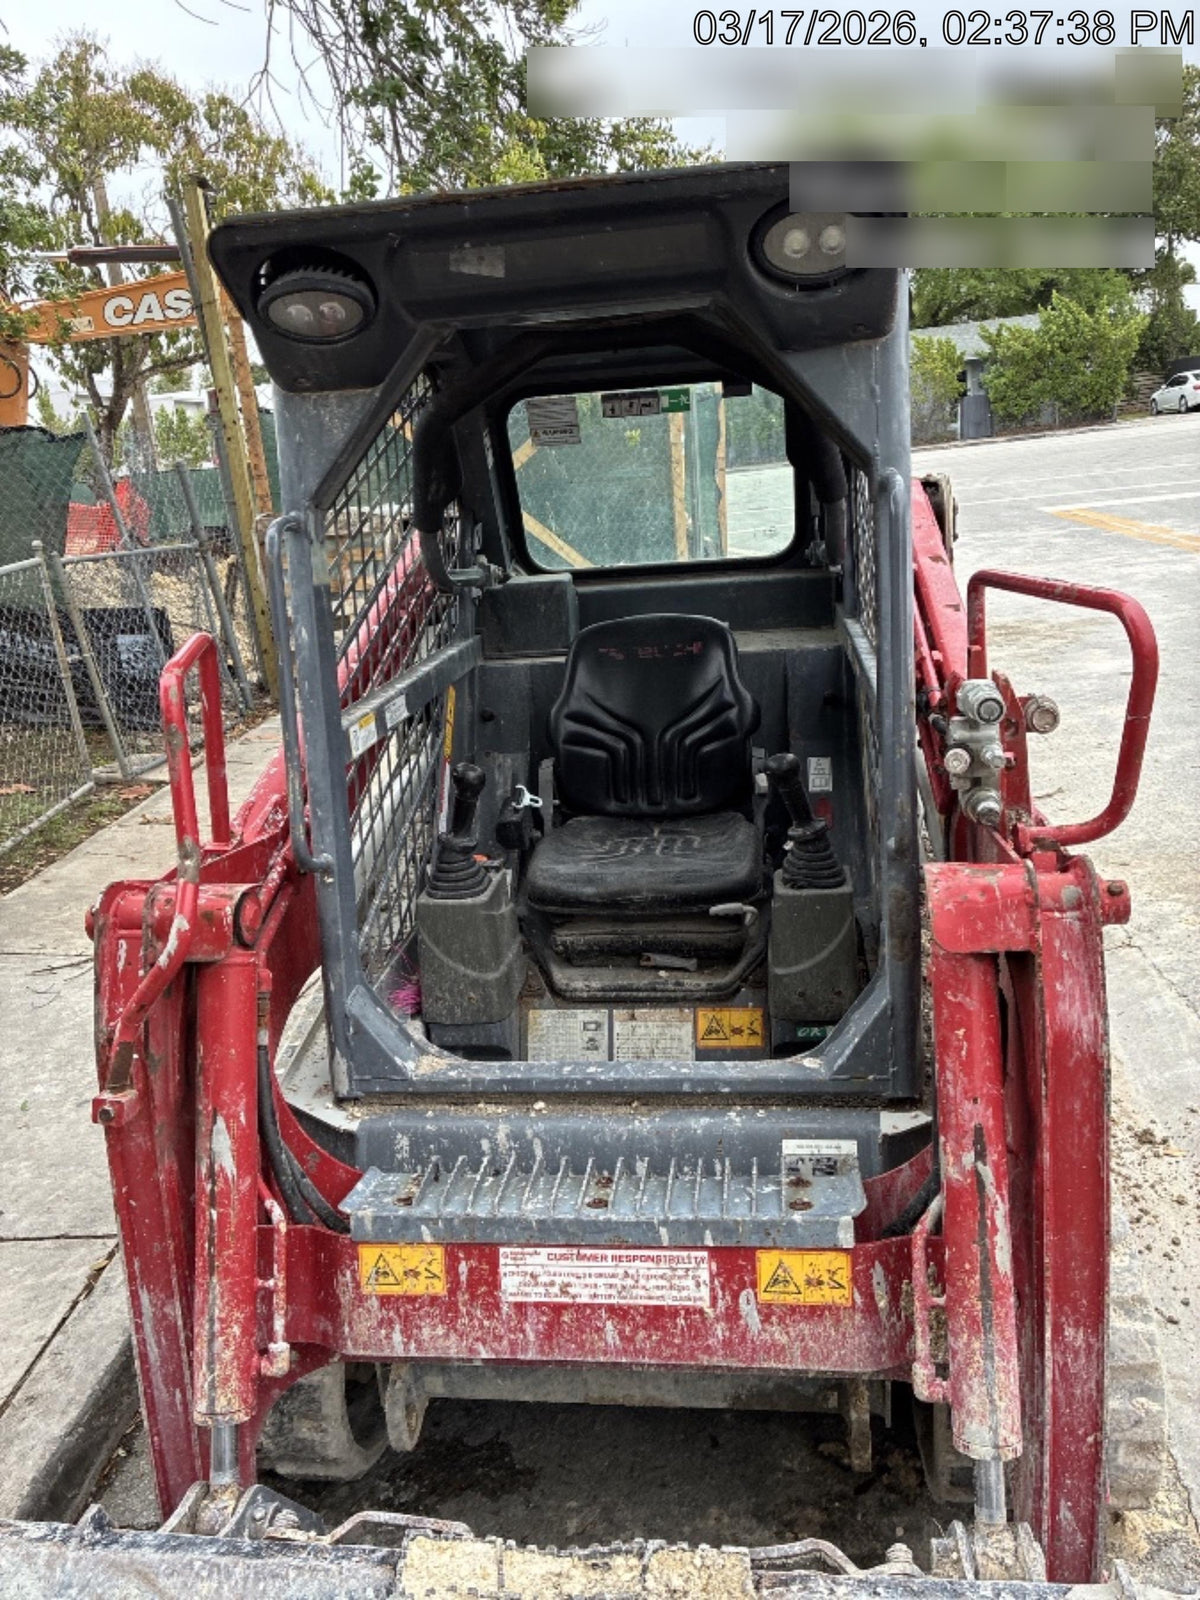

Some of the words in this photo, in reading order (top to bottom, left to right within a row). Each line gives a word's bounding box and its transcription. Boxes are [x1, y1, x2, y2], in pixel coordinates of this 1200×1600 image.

[103, 289, 194, 327] CAS
[547, 1252, 608, 1263] CUSTOMER
[611, 1254, 706, 1265] RESPONSIBILITY
